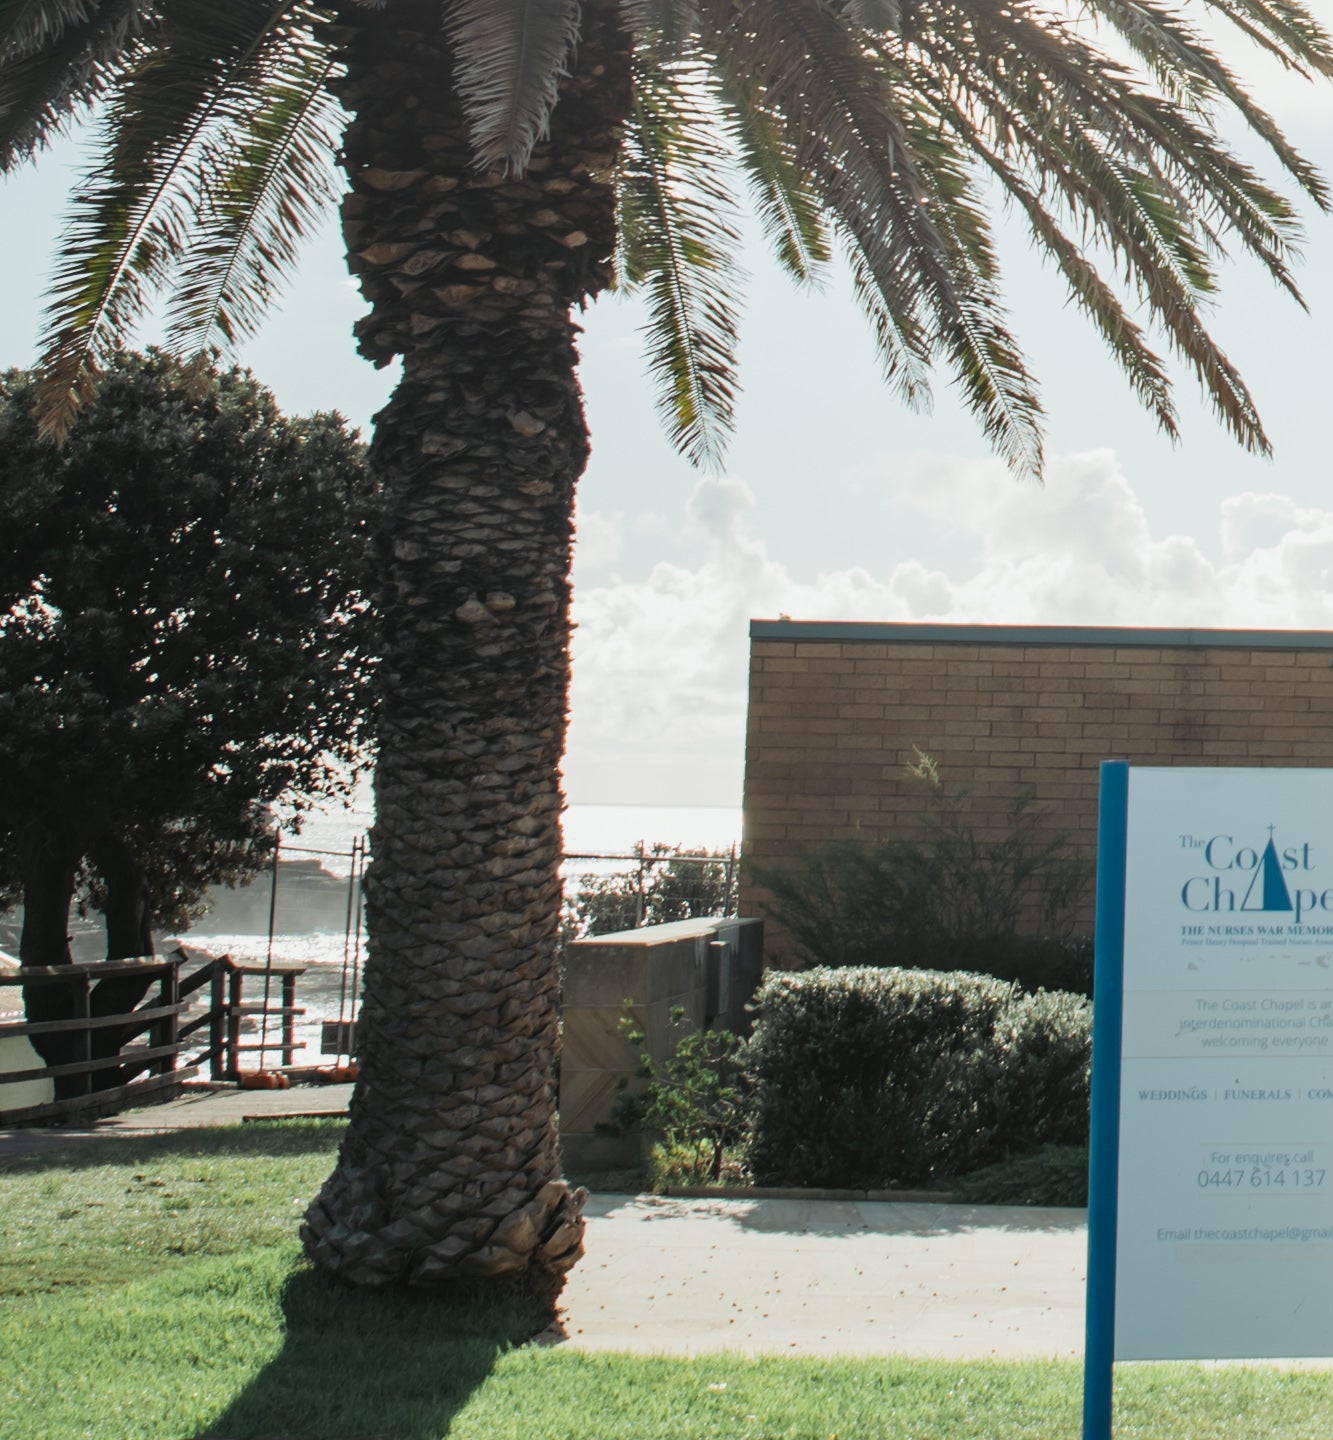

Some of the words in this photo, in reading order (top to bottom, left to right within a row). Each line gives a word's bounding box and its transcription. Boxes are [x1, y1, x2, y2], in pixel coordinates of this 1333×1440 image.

[1178, 834, 1206, 848] The
[1180, 926, 1204, 935] THE
[1207, 926, 1254, 935] NURSES
[1257, 926, 1284, 935] WAR
[1195, 999, 1218, 1011] The
[1222, 999, 1257, 1011] Coast
[1260, 998, 1304, 1013] Chapel
[1307, 999, 1318, 1011] is
[1180, 1016, 1306, 1030] interdenominational
[1201, 1035, 1268, 1050] welcoming
[1271, 1036, 1329, 1050] everyone
[1138, 1089, 1208, 1101] WEDDINGS
[1223, 1089, 1292, 1101] FUNERALS
[1211, 1151, 1232, 1164] For
[1292, 1150, 1314, 1163] call
[1197, 1169, 1245, 1188] 0447
[1249, 1169, 1285, 1187] 614
[1292, 1169, 1327, 1187] 137
[1156, 1227, 1191, 1241] Email
